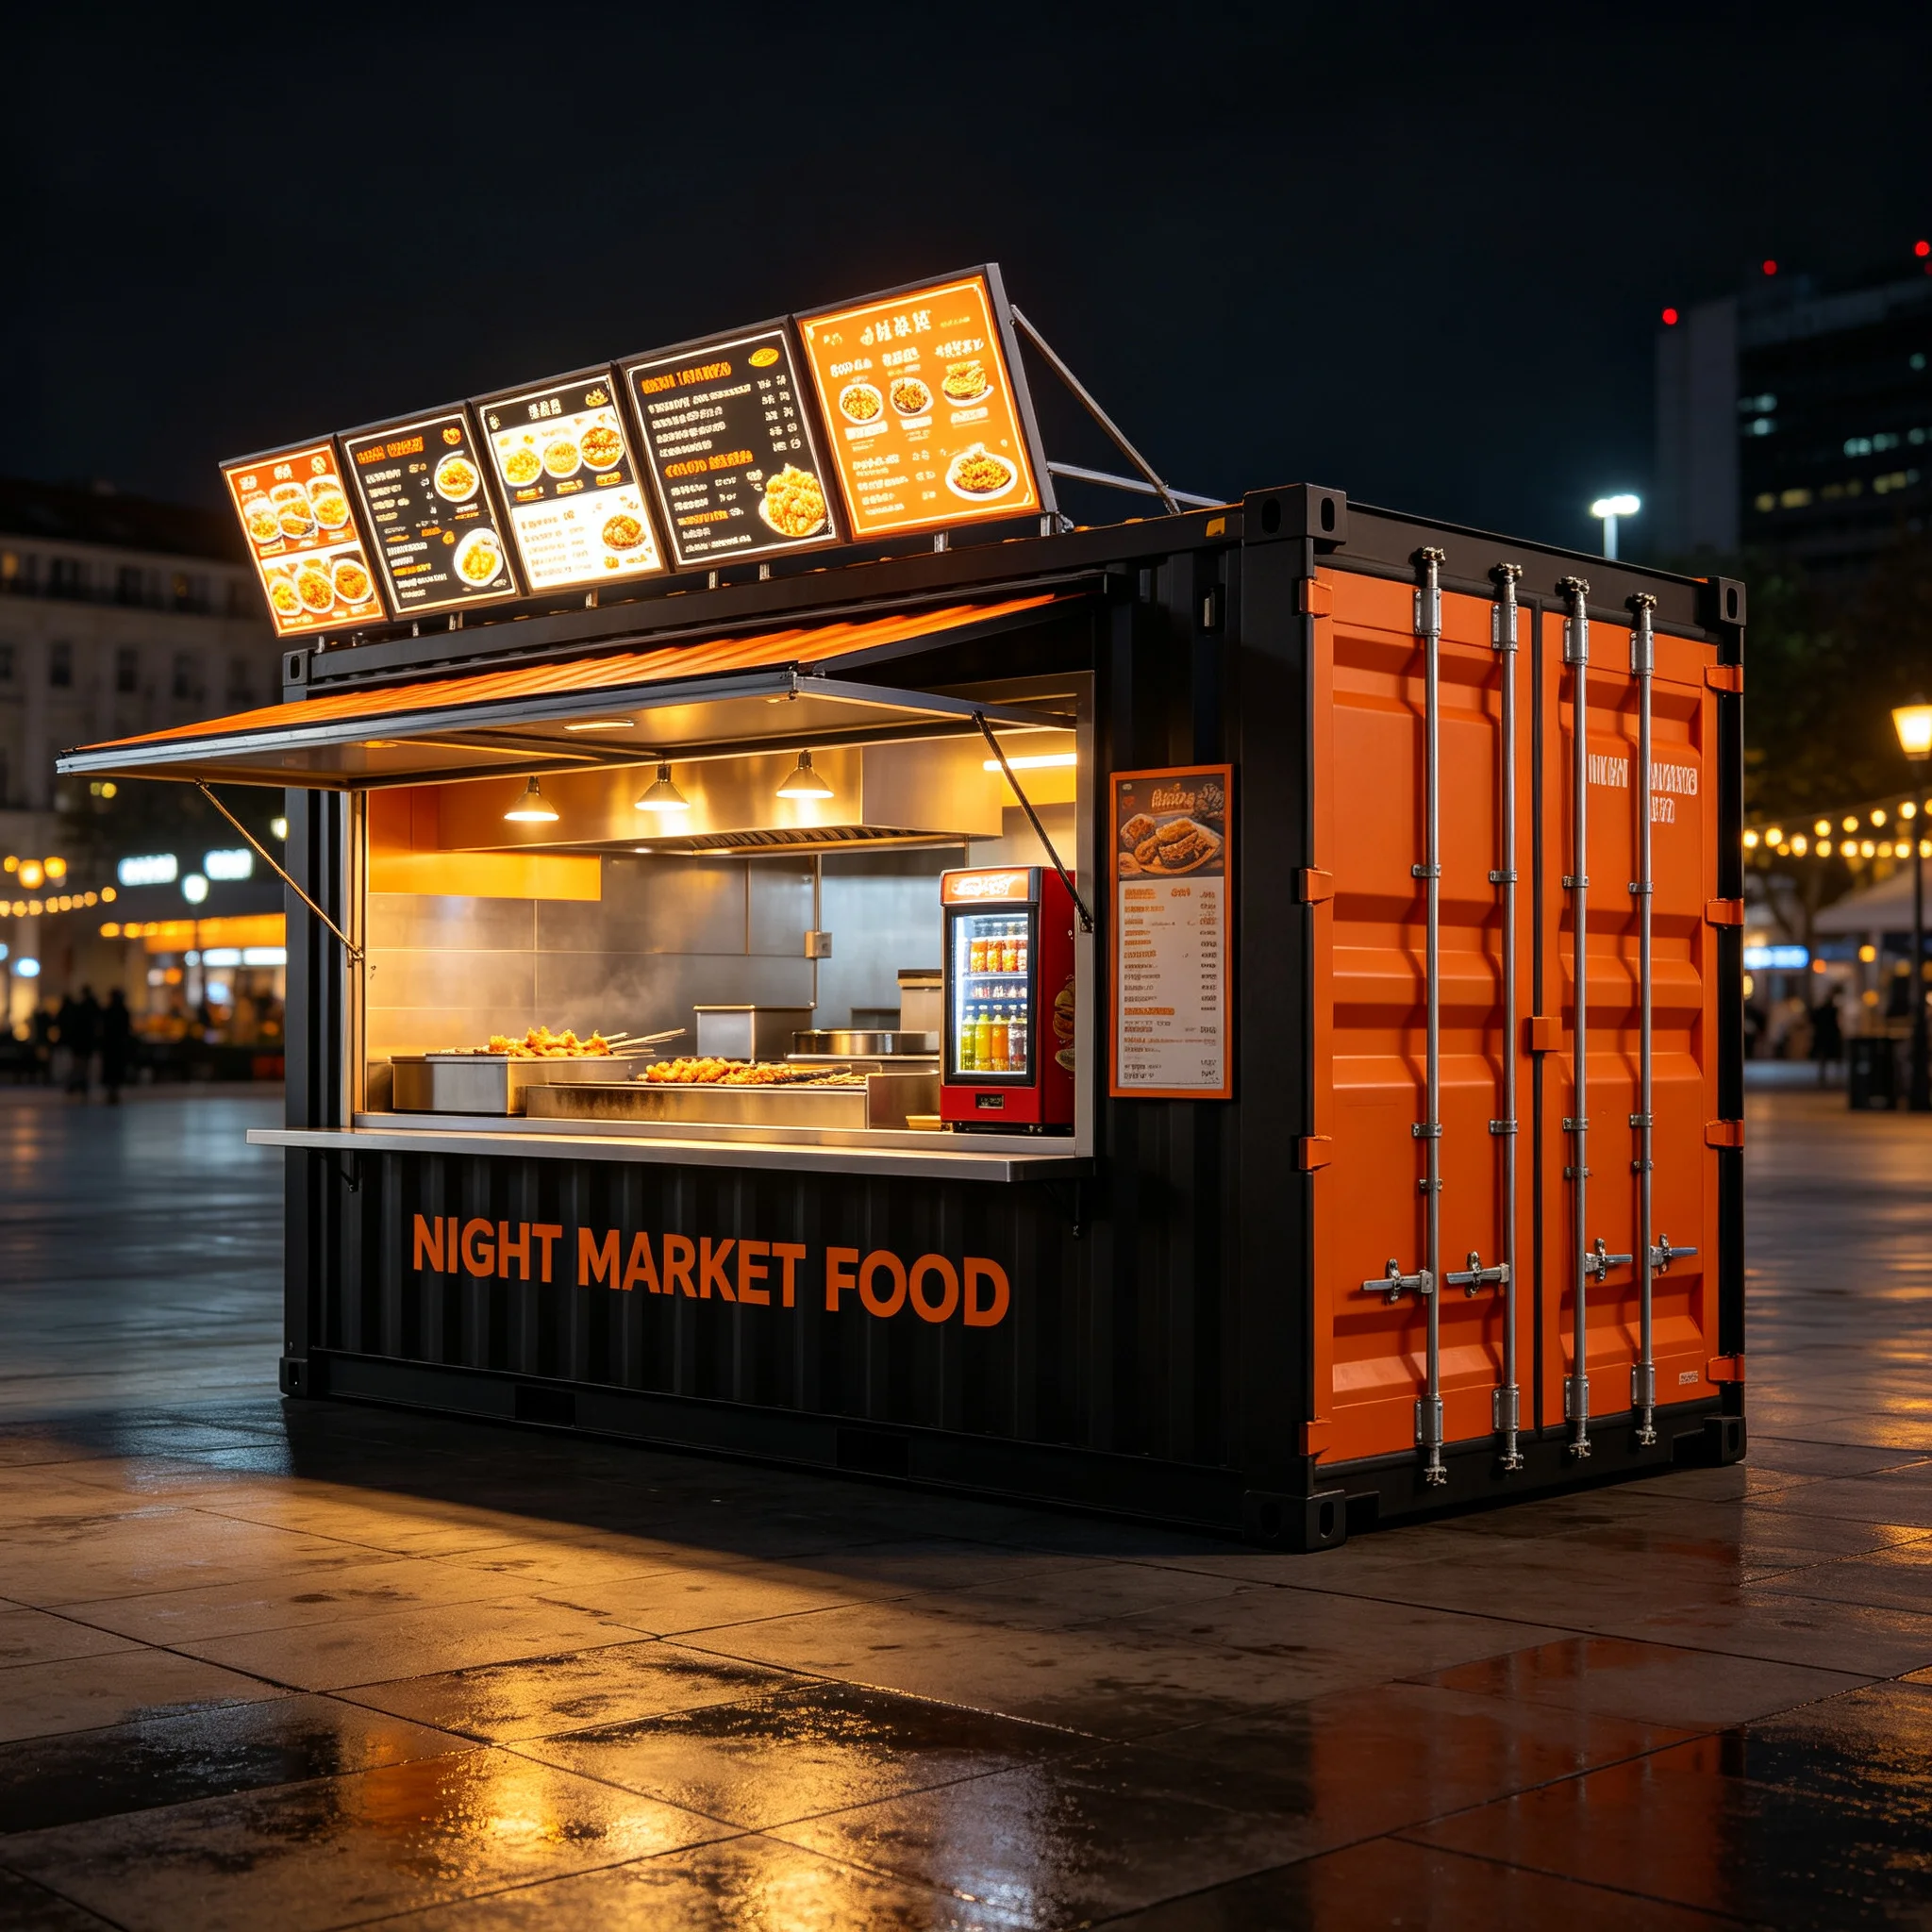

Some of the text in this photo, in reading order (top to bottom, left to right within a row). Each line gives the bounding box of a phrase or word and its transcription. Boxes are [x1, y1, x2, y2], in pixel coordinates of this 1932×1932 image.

[413, 1213, 1010, 1327] NIGHT MARKET FOOD
